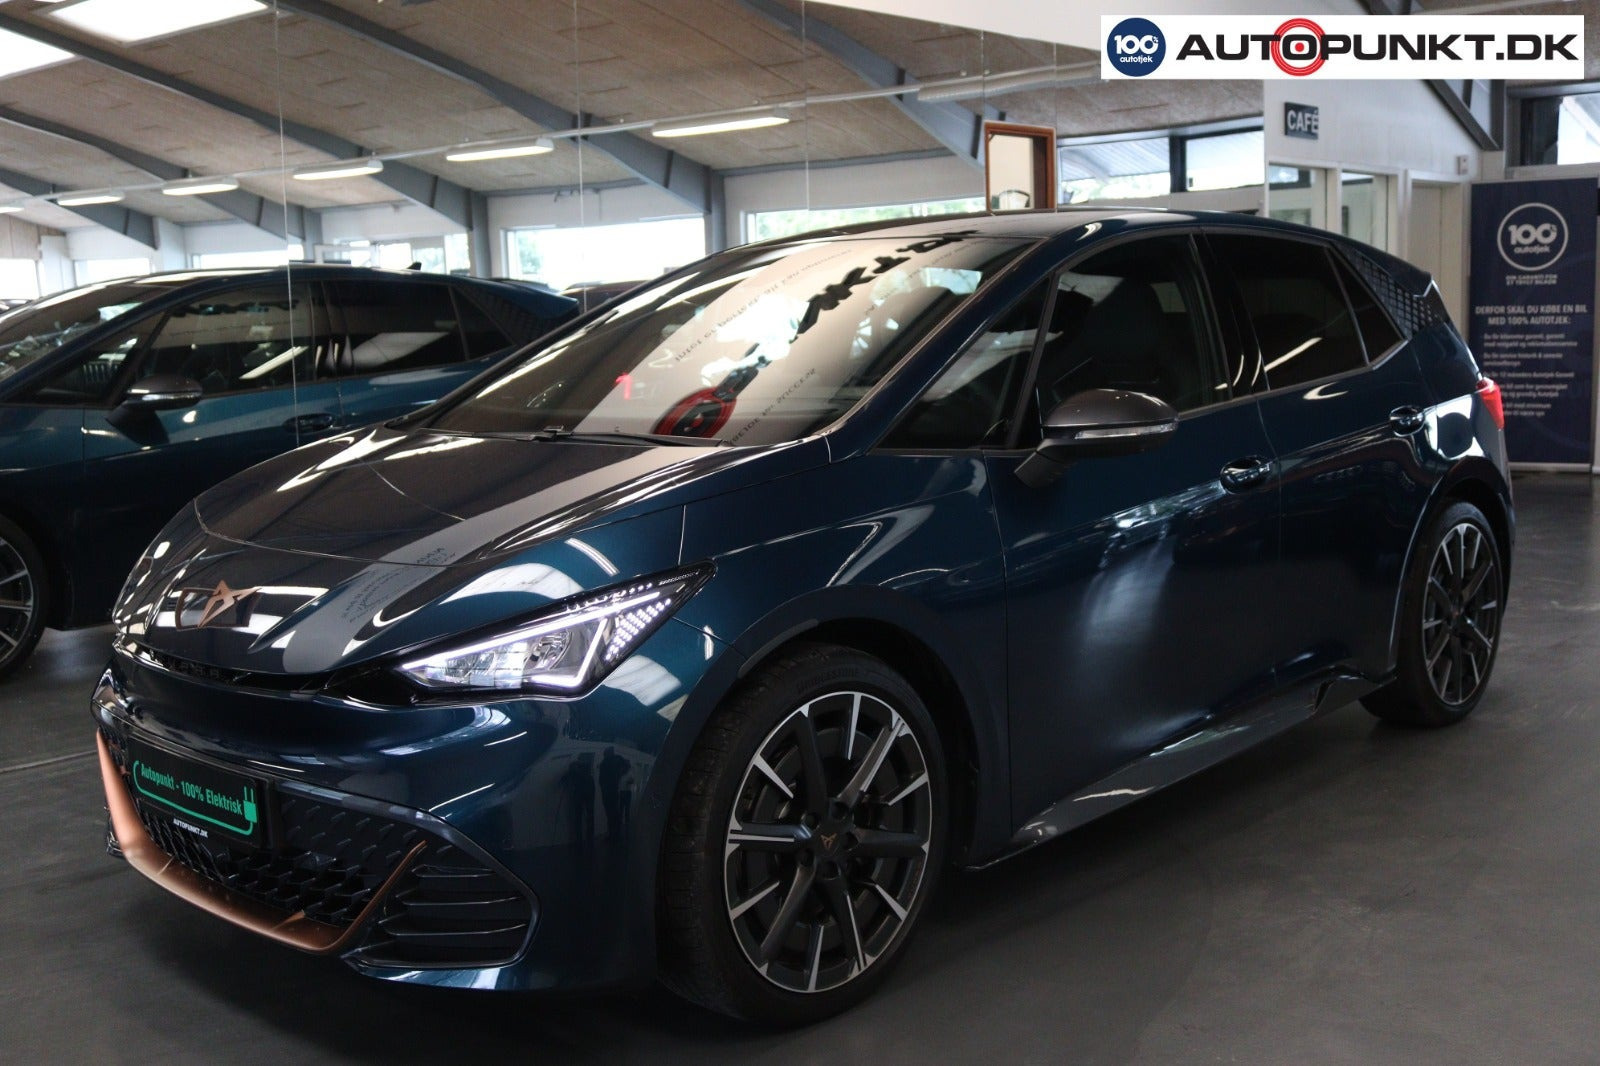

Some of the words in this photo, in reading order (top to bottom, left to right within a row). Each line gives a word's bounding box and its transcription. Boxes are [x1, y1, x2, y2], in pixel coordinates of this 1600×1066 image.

[1514, 245, 1550, 254] autotjek
[1475, 305, 1505, 314] DERFOR
[1506, 305, 1525, 314] SKAL
[1526, 305, 1539, 314] DU
[1540, 304, 1560, 313] KØBE
[1562, 304, 1574, 313] EN
[1574, 304, 1587, 313] BIL
[1488, 316, 1506, 325] MED
[1507, 316, 1529, 325] 100%
[141, 763, 175, 790] Autopunkt
[181, 780, 204, 801] 100%
[206, 788, 243, 816] Elektrisk
[173, 818, 209, 838] AUTOPUNKT.DK
